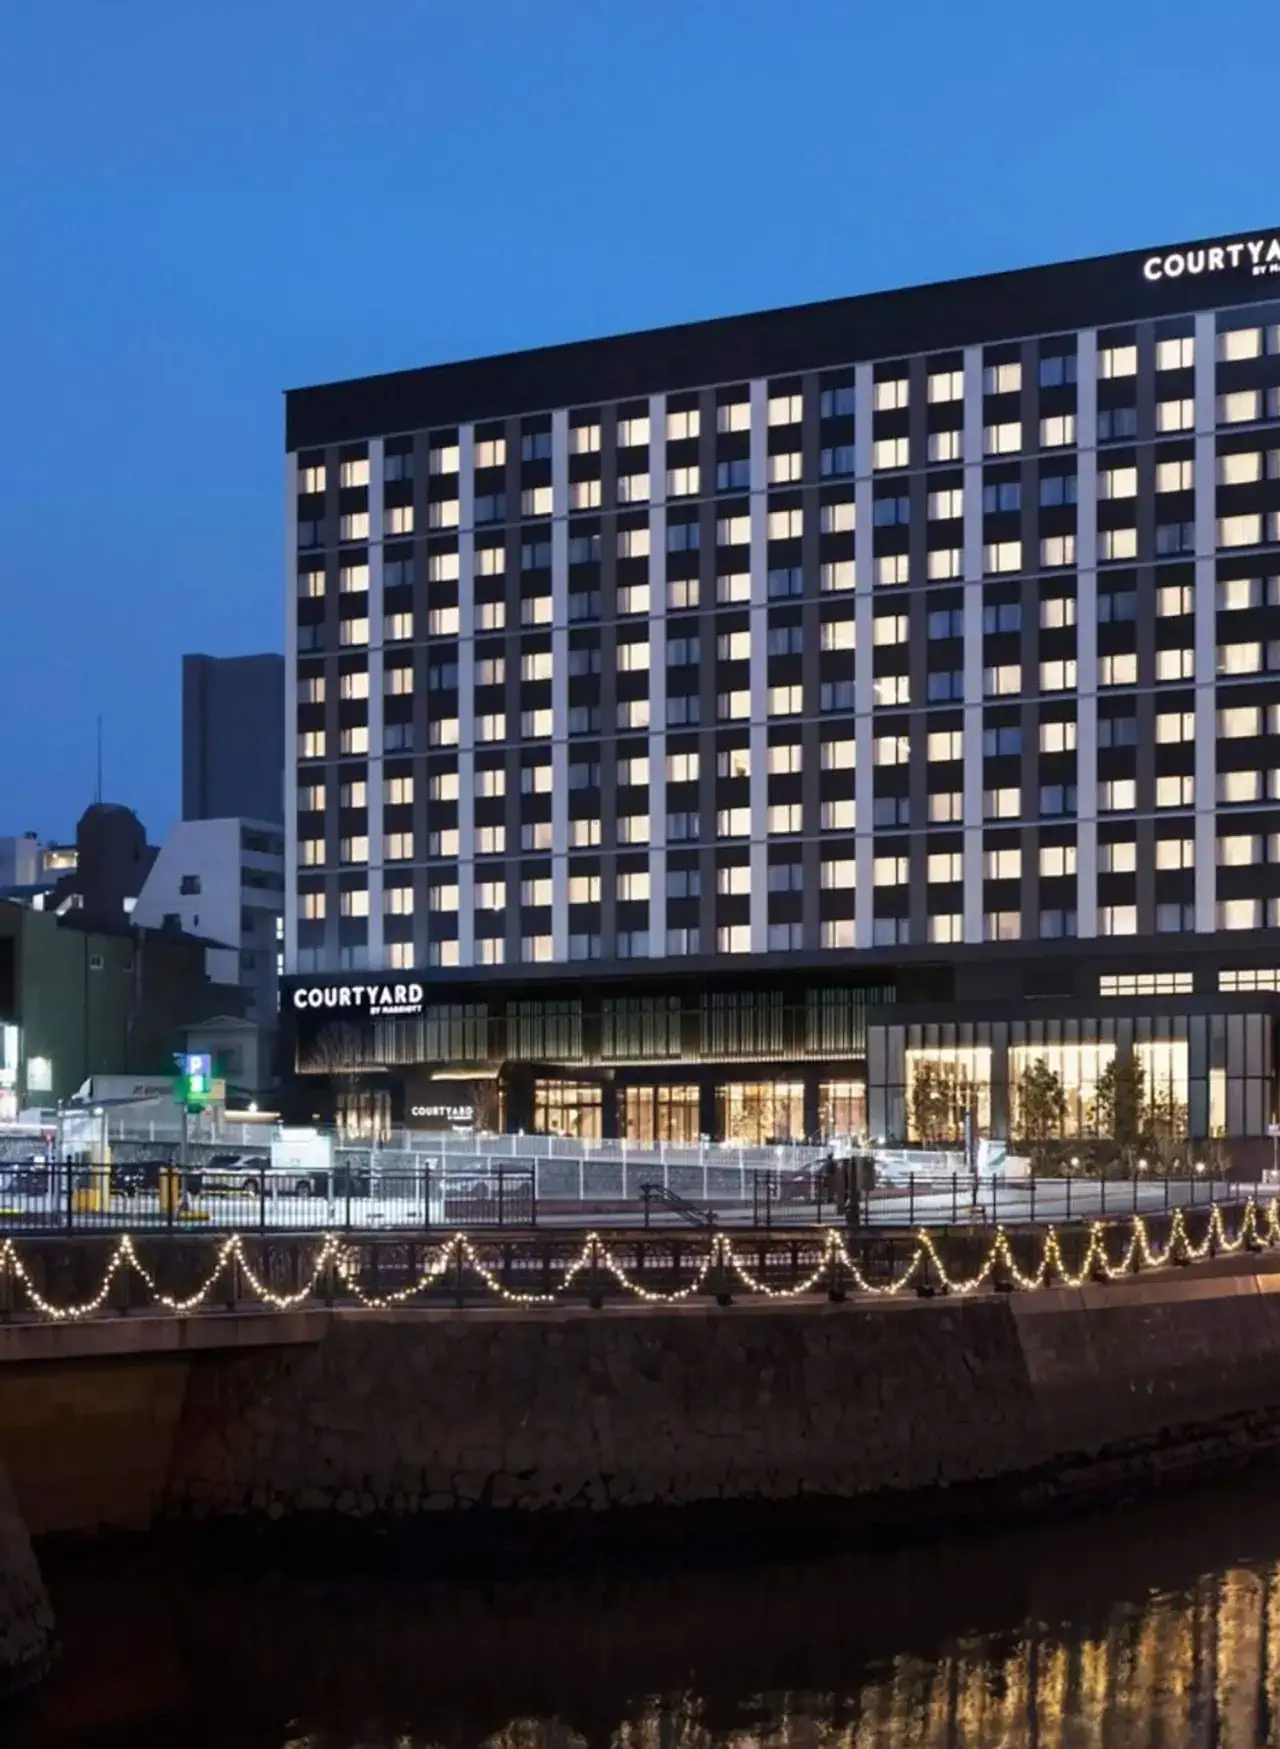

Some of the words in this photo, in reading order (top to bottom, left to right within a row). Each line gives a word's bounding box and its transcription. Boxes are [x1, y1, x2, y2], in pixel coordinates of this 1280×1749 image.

[1252, 264, 1267, 276] BY
[293, 983, 424, 1009] COURTYARD
[411, 1105, 474, 1117] COURTYARD
